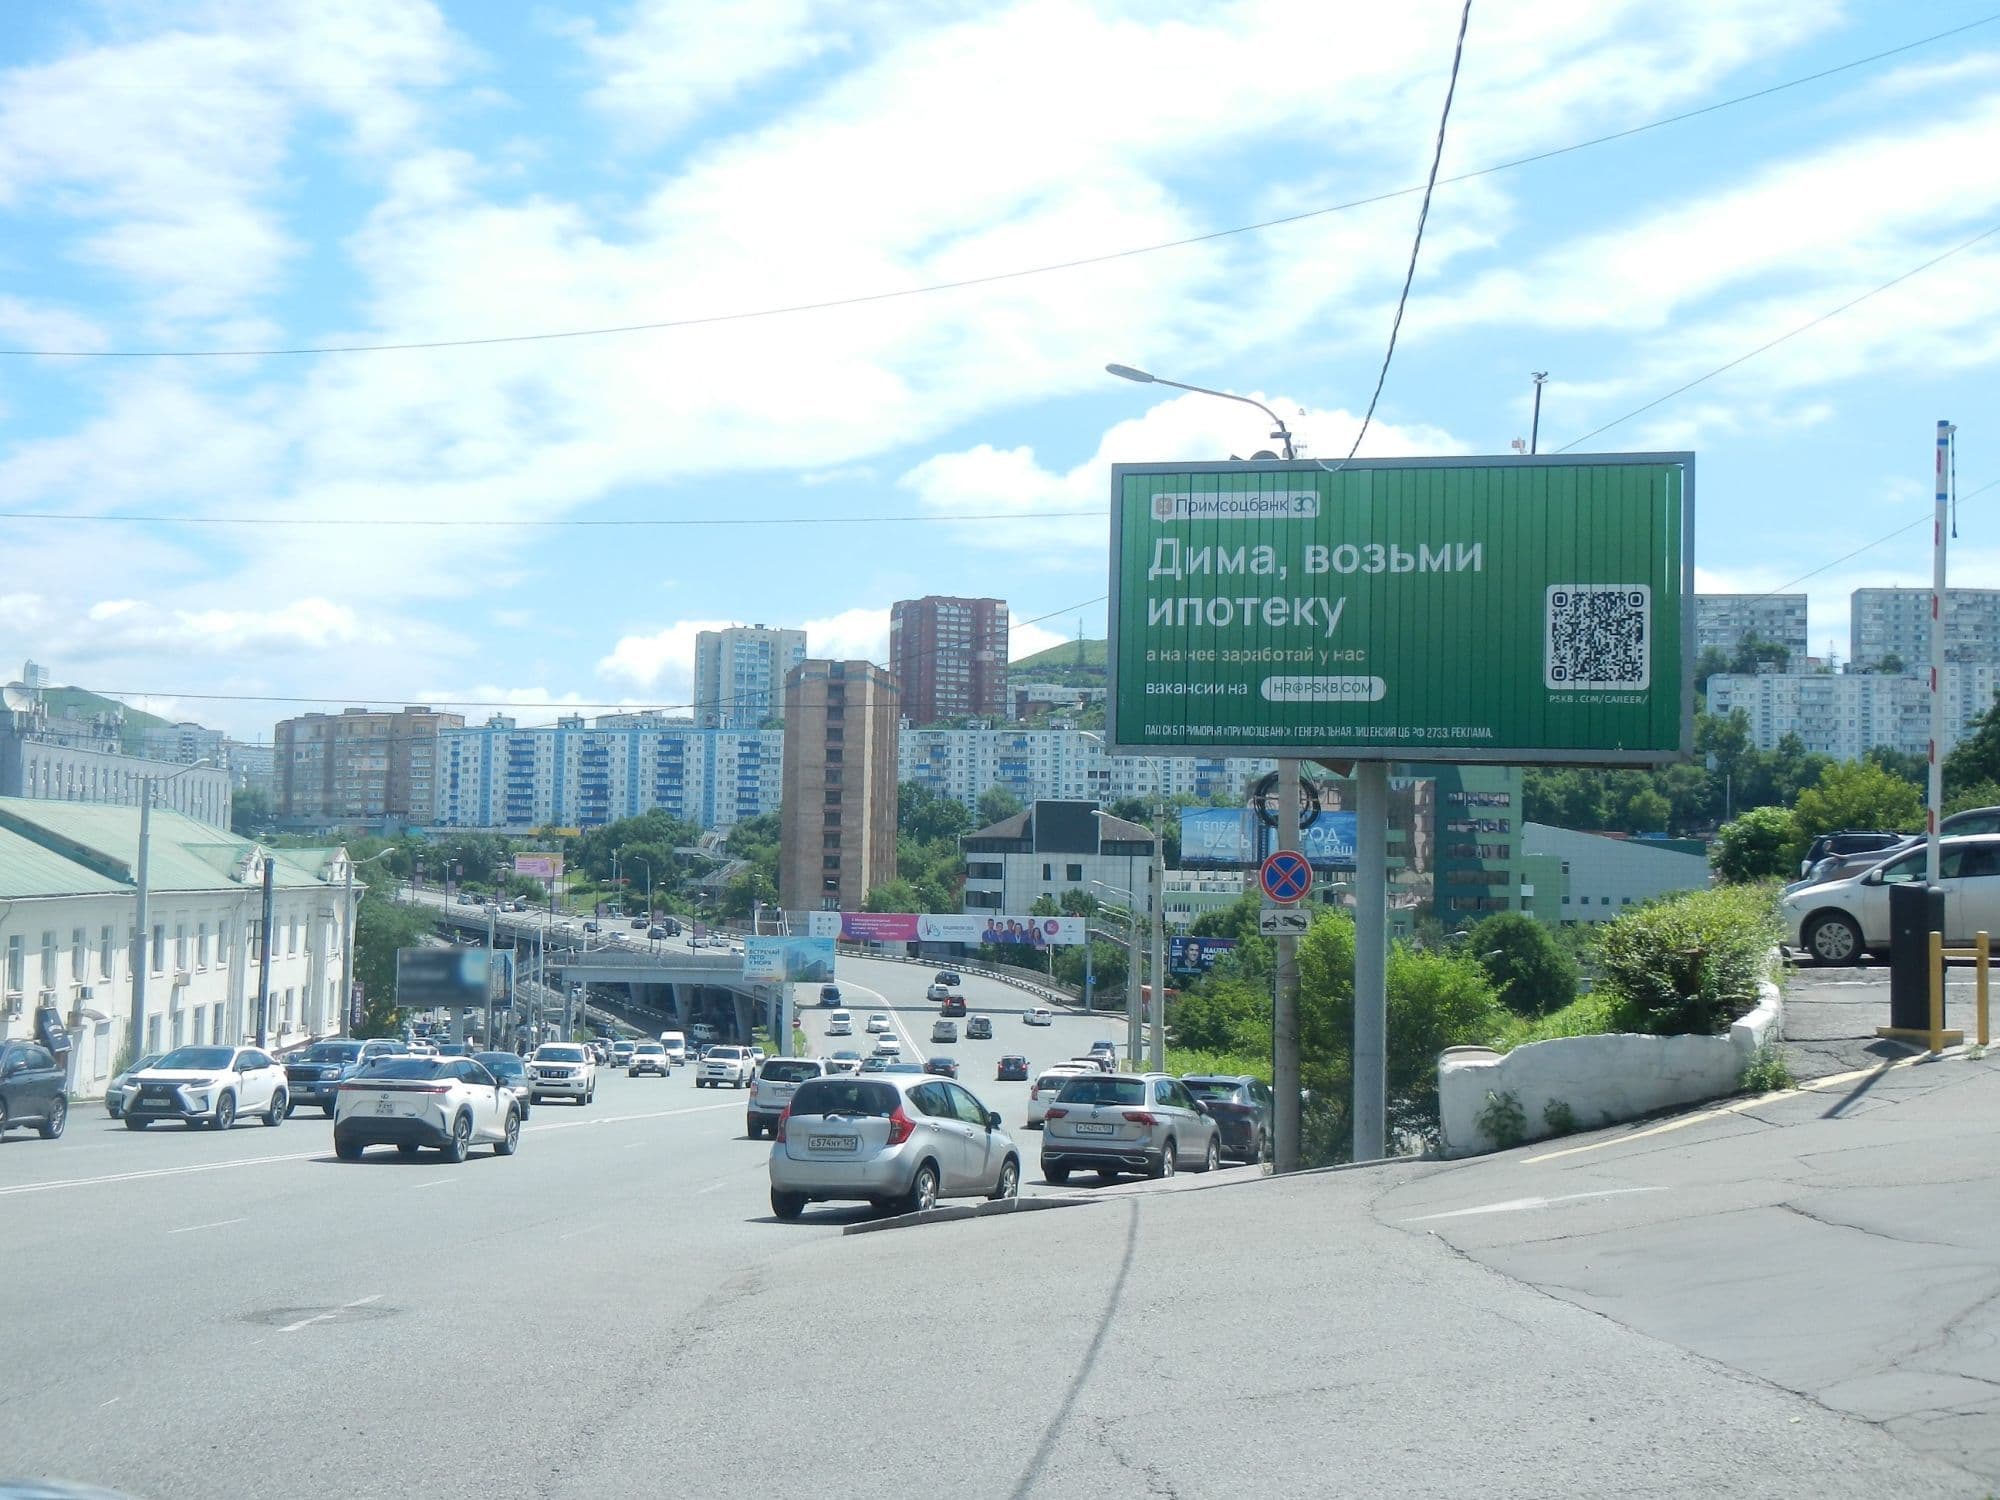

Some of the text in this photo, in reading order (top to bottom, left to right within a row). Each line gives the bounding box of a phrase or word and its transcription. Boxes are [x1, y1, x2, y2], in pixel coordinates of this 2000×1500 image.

[1176, 498, 1288, 516] Примсоцбанк
[1148, 538, 1482, 580] Дима, возьми
[1148, 597, 1346, 638] ипотеку
[1146, 647, 1365, 665] а на нее заработай у нас
[1146, 682, 1247, 694] вакансии на
[1274, 682, 1372, 694] HR@PSKB.COM
[1145, 724, 1160, 735] ПАО
[1163, 724, 1178, 736] СКБ
[1179, 725, 1222, 736] ПРИМОРЬЯ
[1324, 845, 1353, 856] ВАШ
